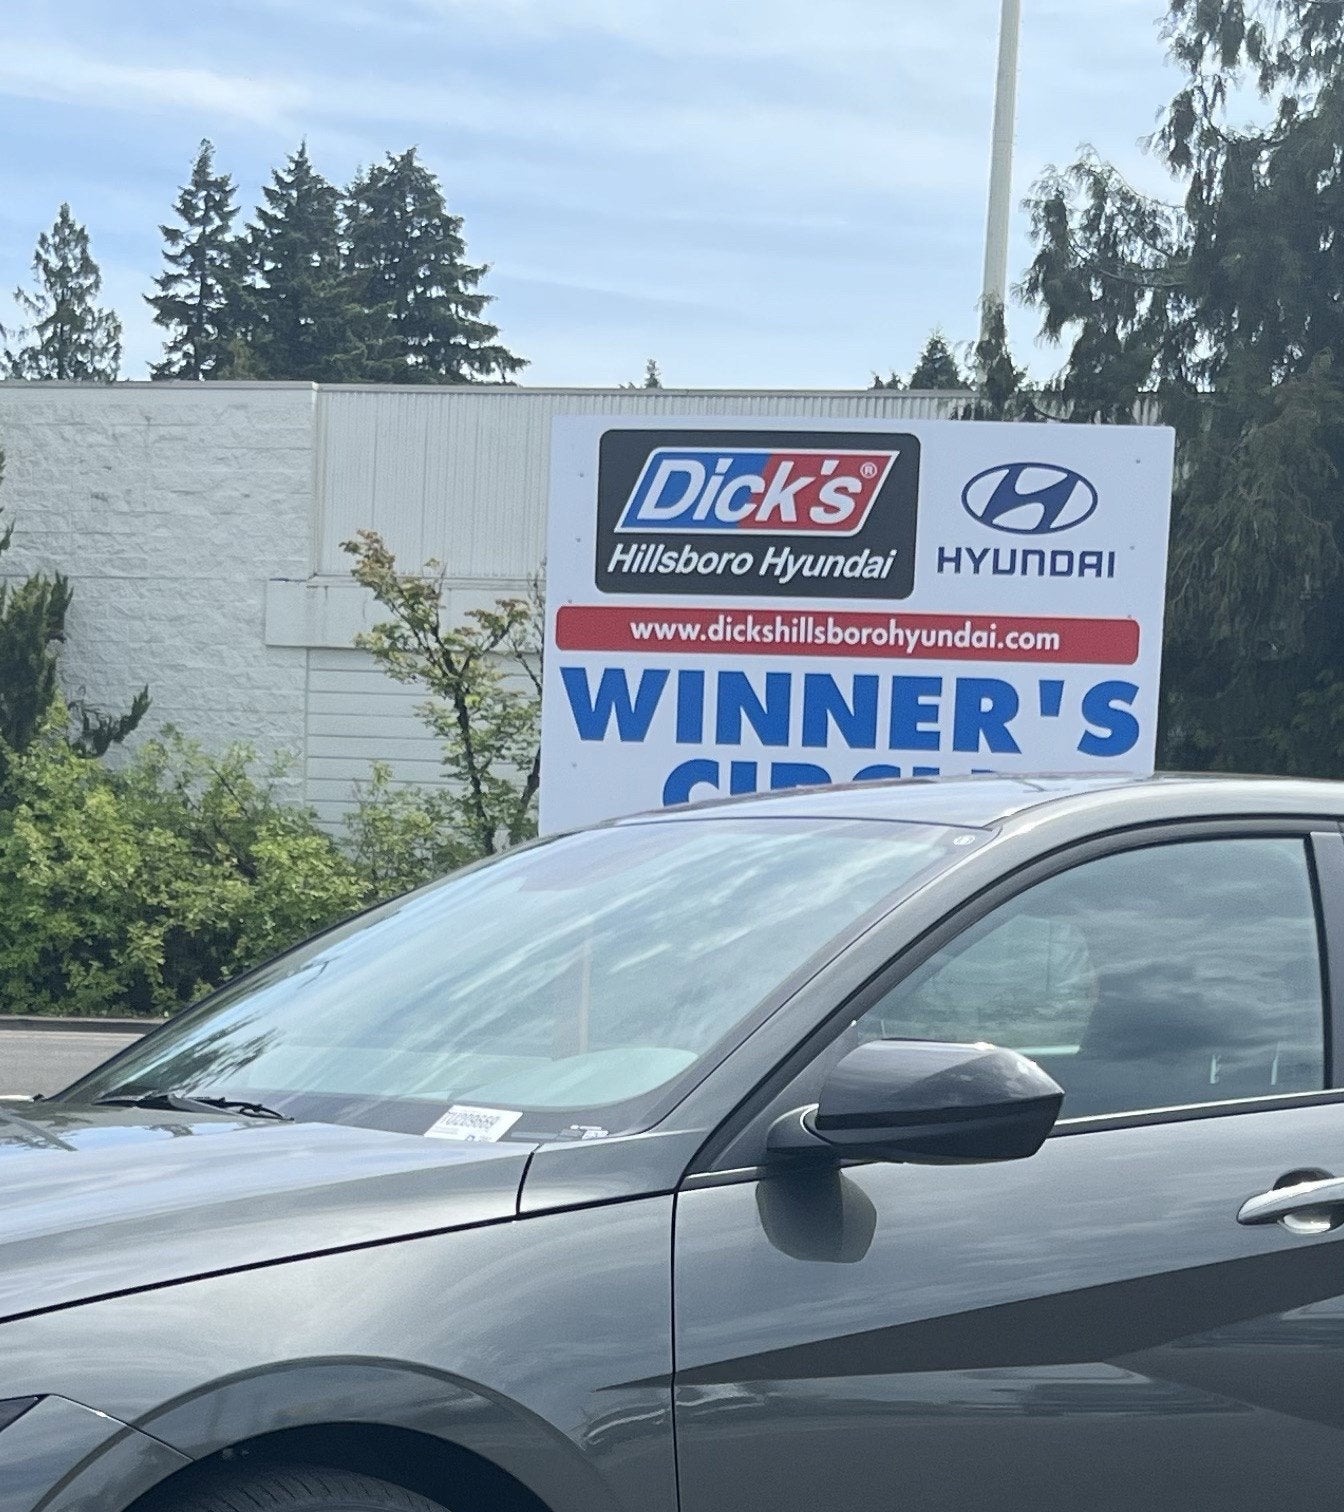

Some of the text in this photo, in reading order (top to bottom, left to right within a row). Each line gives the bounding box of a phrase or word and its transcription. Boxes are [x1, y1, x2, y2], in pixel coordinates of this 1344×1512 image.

[608, 544, 897, 583] Hillsboro Hyundai
[937, 547, 1117, 579] HYUNDAI
[630, 615, 1060, 654] www.dickshillsborohyundai.com
[560, 666, 1141, 758] WINNER'S
